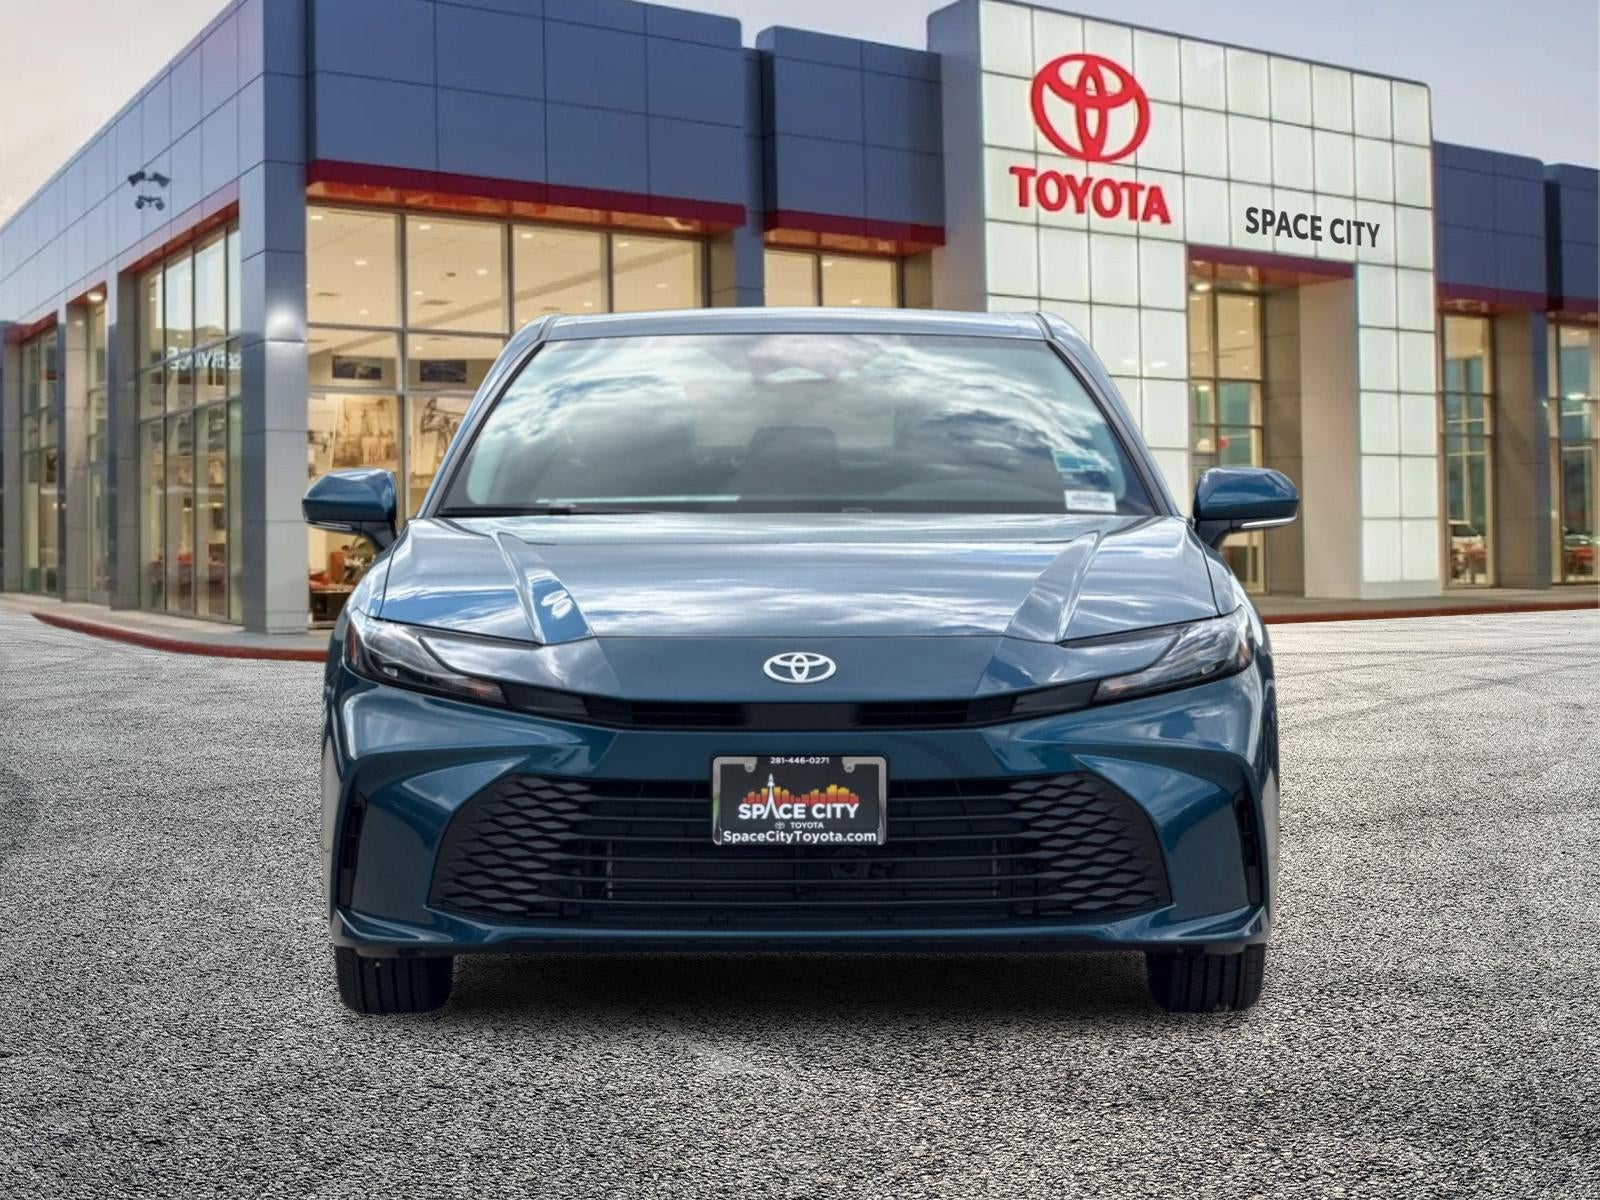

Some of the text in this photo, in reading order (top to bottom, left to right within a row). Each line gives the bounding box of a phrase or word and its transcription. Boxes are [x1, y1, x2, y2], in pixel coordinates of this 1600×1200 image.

[1009, 166, 1171, 225] TOYOTA
[1245, 206, 1381, 249] SPACE CITY
[770, 756, 830, 765] 281-446-0271
[738, 803, 860, 820] SPACE CITY
[790, 821, 825, 830] TOYOTA
[723, 830, 877, 844] SpaceCityToyota.com
